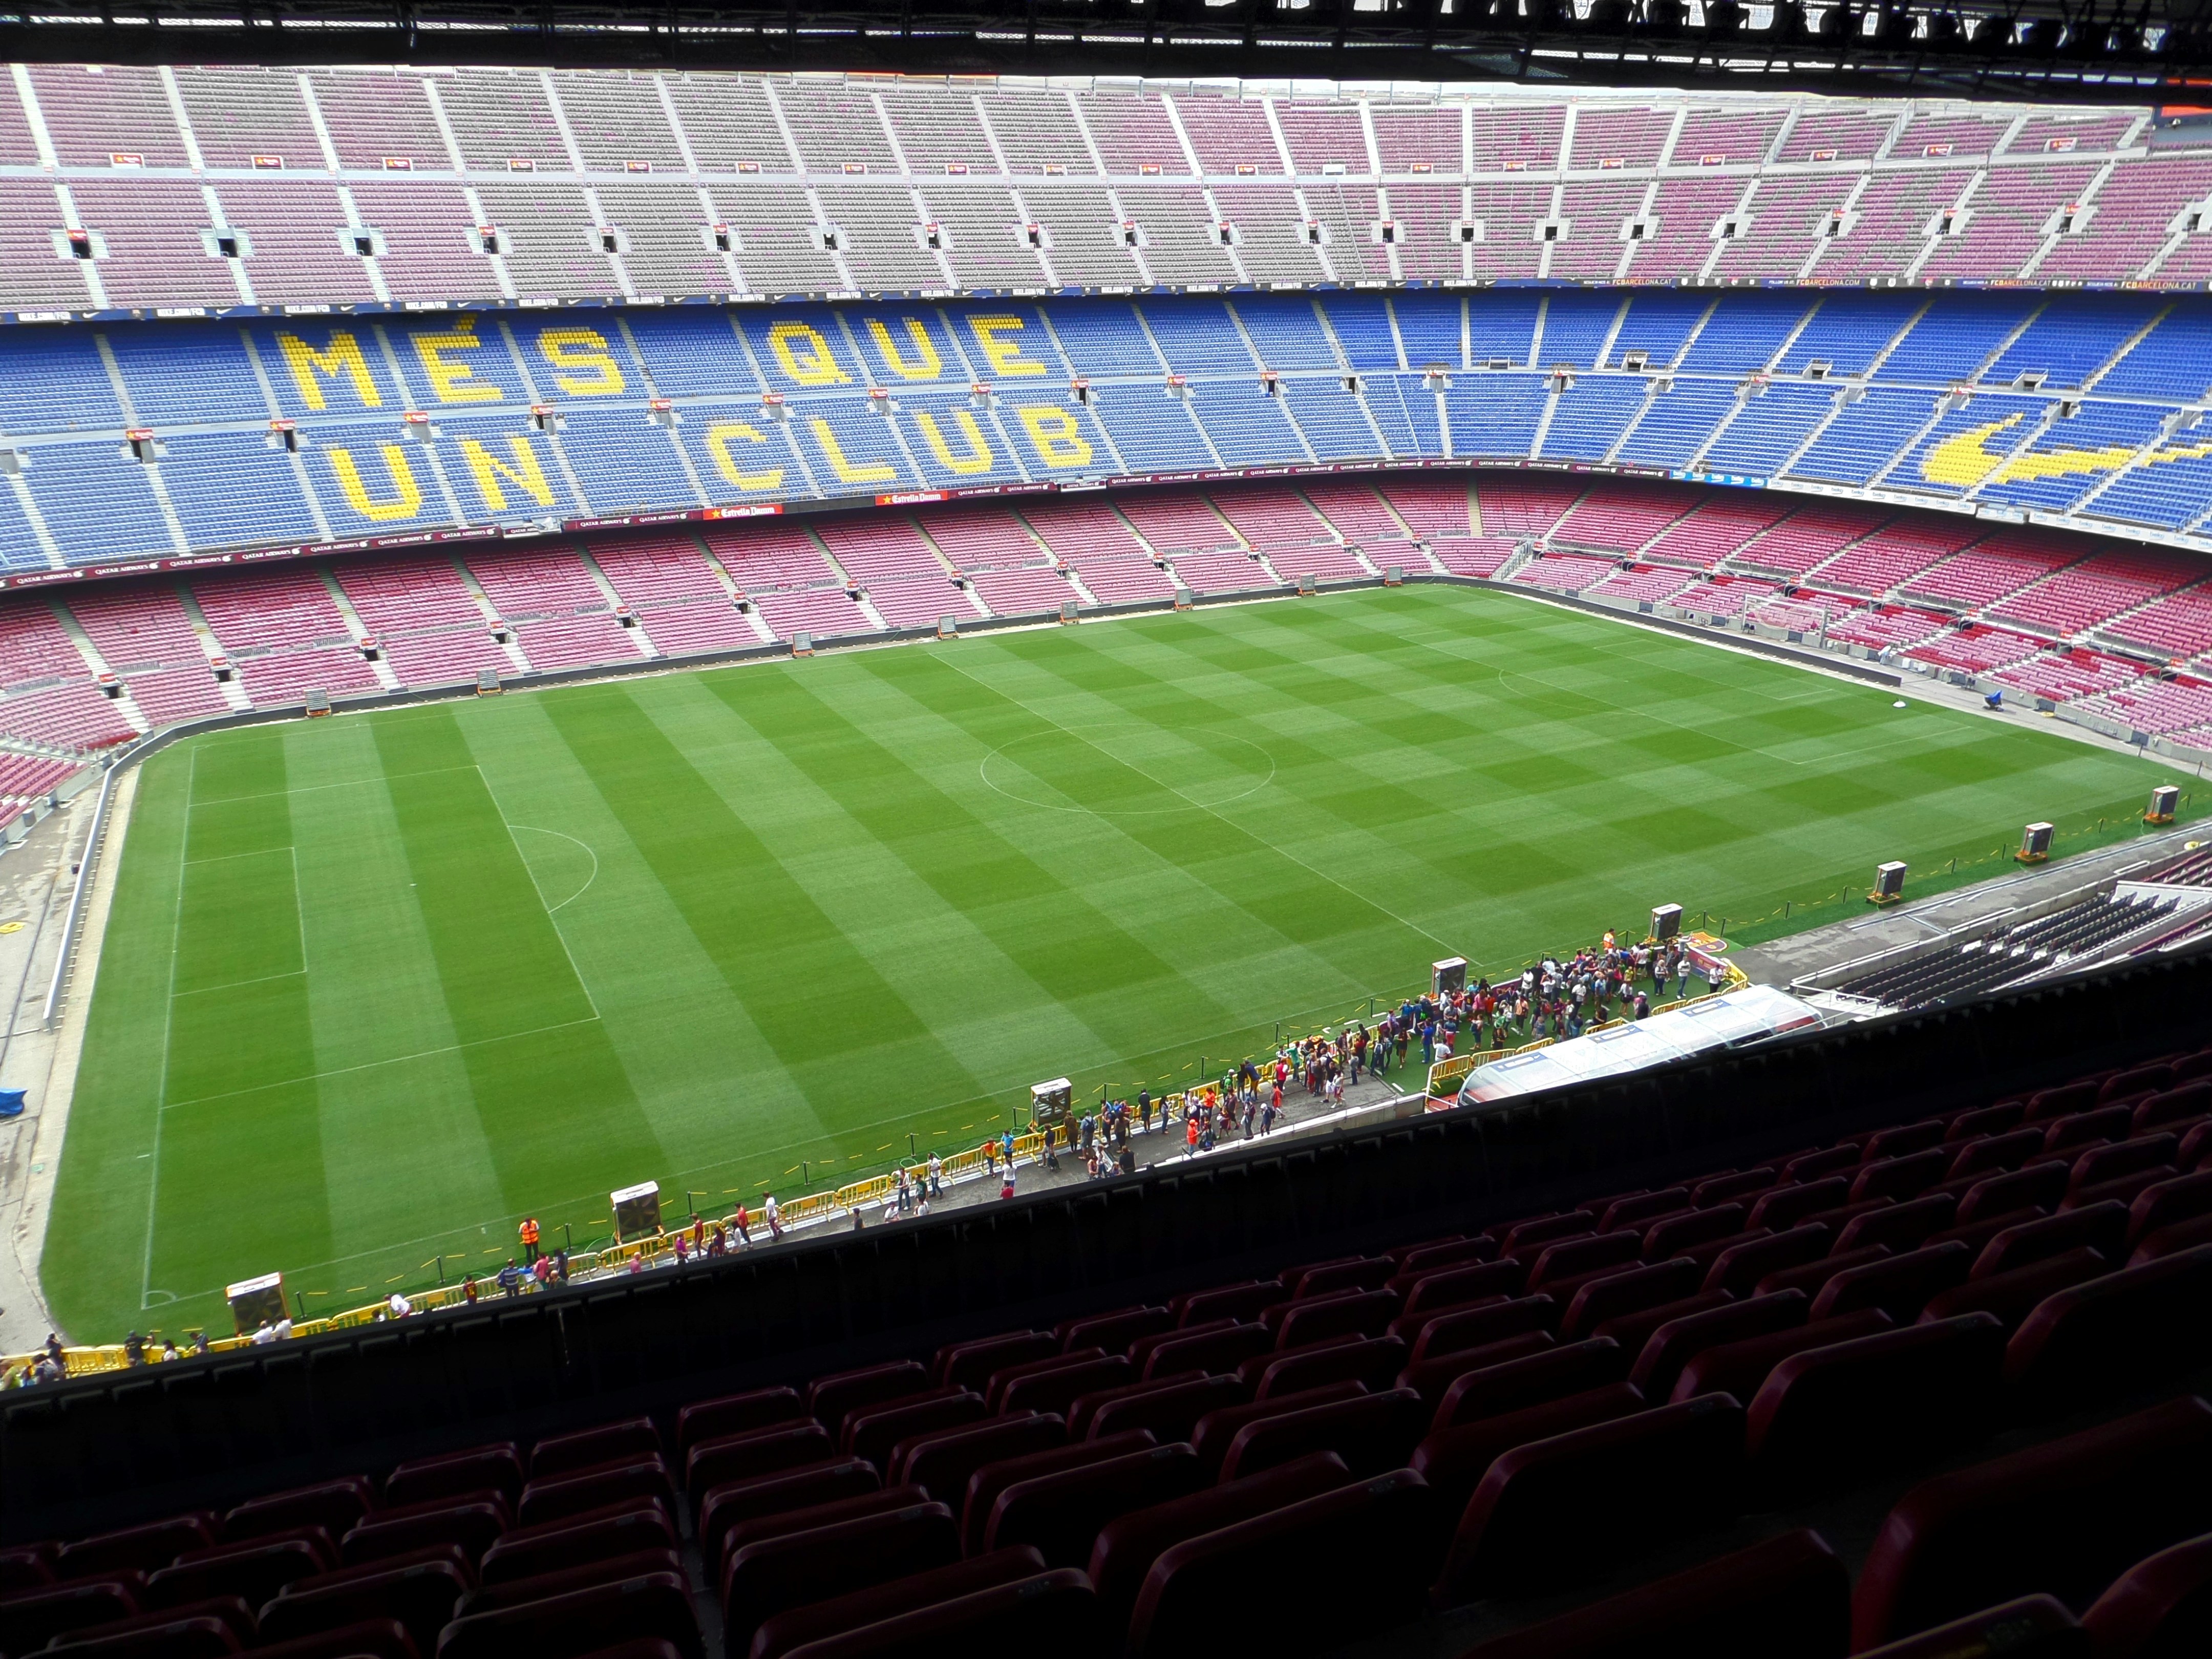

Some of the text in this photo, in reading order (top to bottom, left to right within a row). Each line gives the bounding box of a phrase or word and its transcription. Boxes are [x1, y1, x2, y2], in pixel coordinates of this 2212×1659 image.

[2121, 281, 2197, 289] FCBARCELONA.CAT
[280, 313, 1047, 410] MÉS QUE
[329, 407, 1094, 522] UN CLUB
[891, 493, 941, 504] Estrella Damm
[721, 506, 775, 518] Estrella Damm
[16, 576, 44, 584] QATAR
